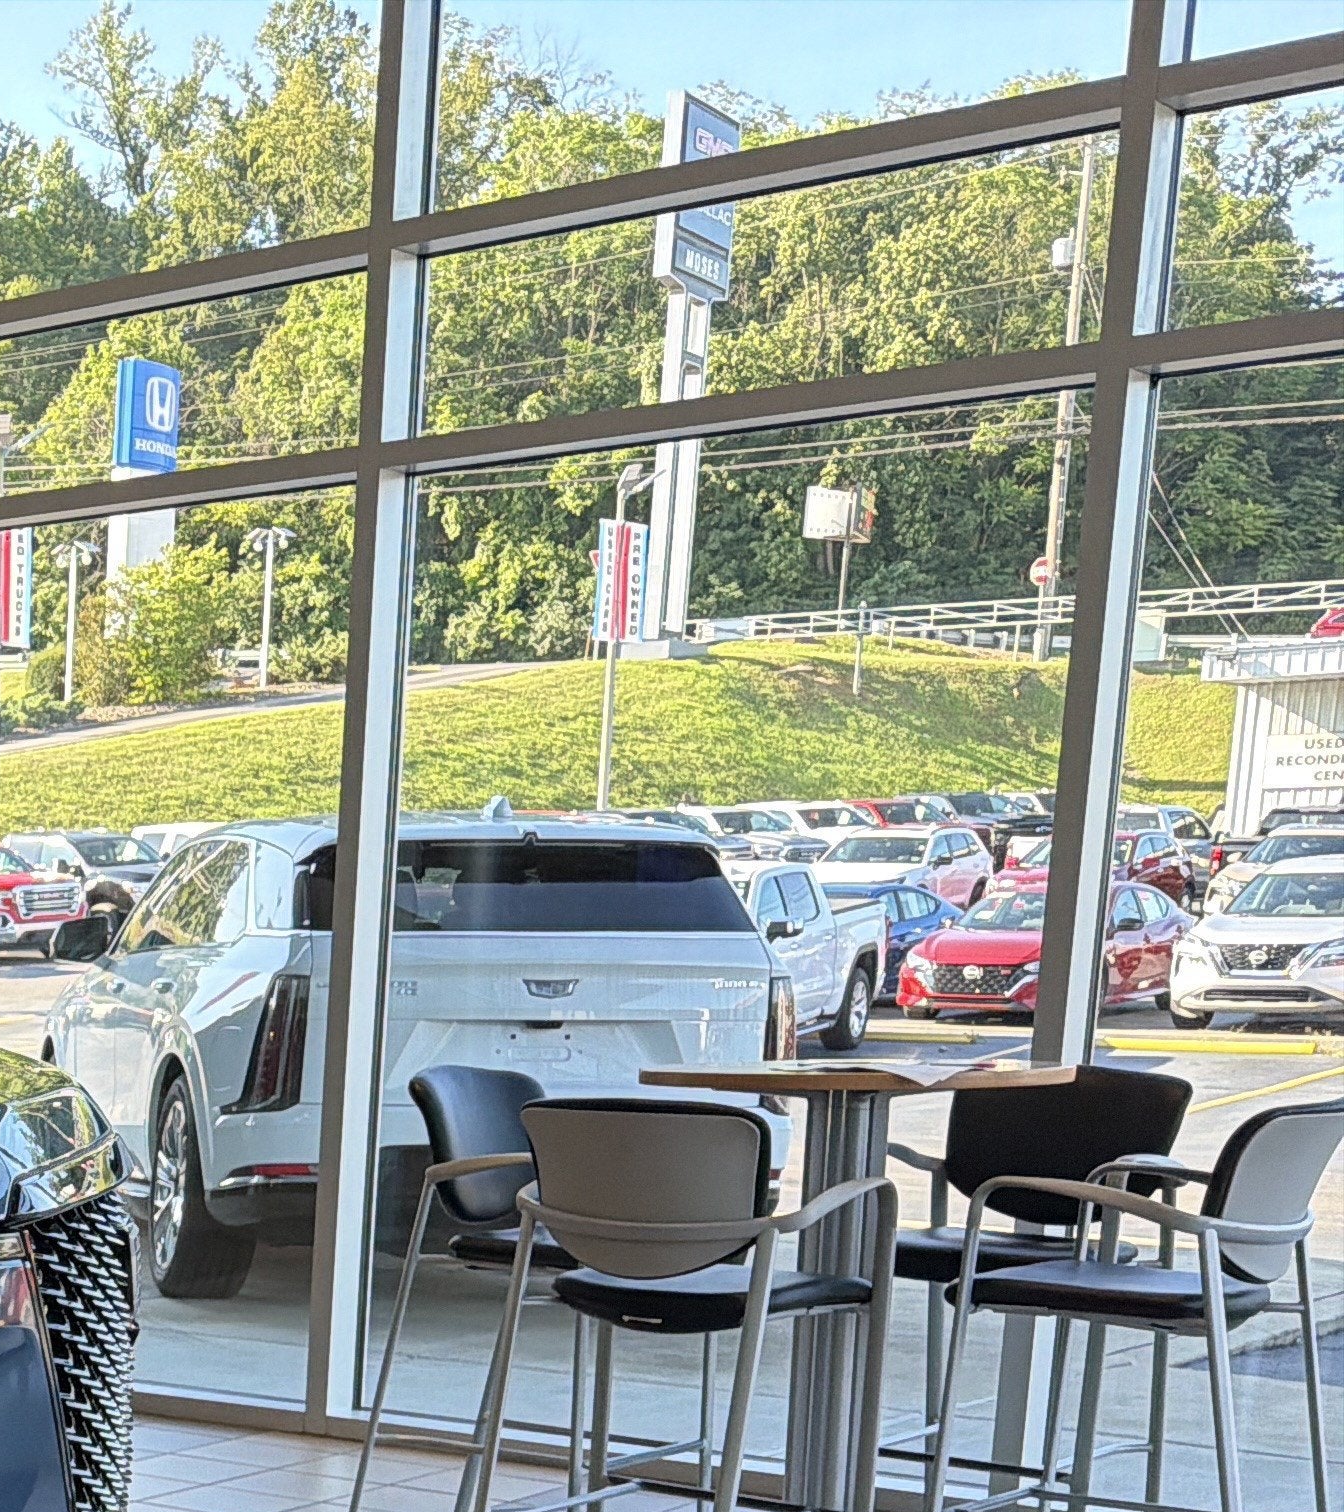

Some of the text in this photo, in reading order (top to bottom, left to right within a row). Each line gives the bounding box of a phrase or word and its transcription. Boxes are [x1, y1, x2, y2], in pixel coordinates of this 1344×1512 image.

[685, 248, 720, 281] MOSES
[15, 563, 25, 636] TRUCKS
[629, 574, 640, 635] OWNED
[1305, 738, 1344, 749] USED
